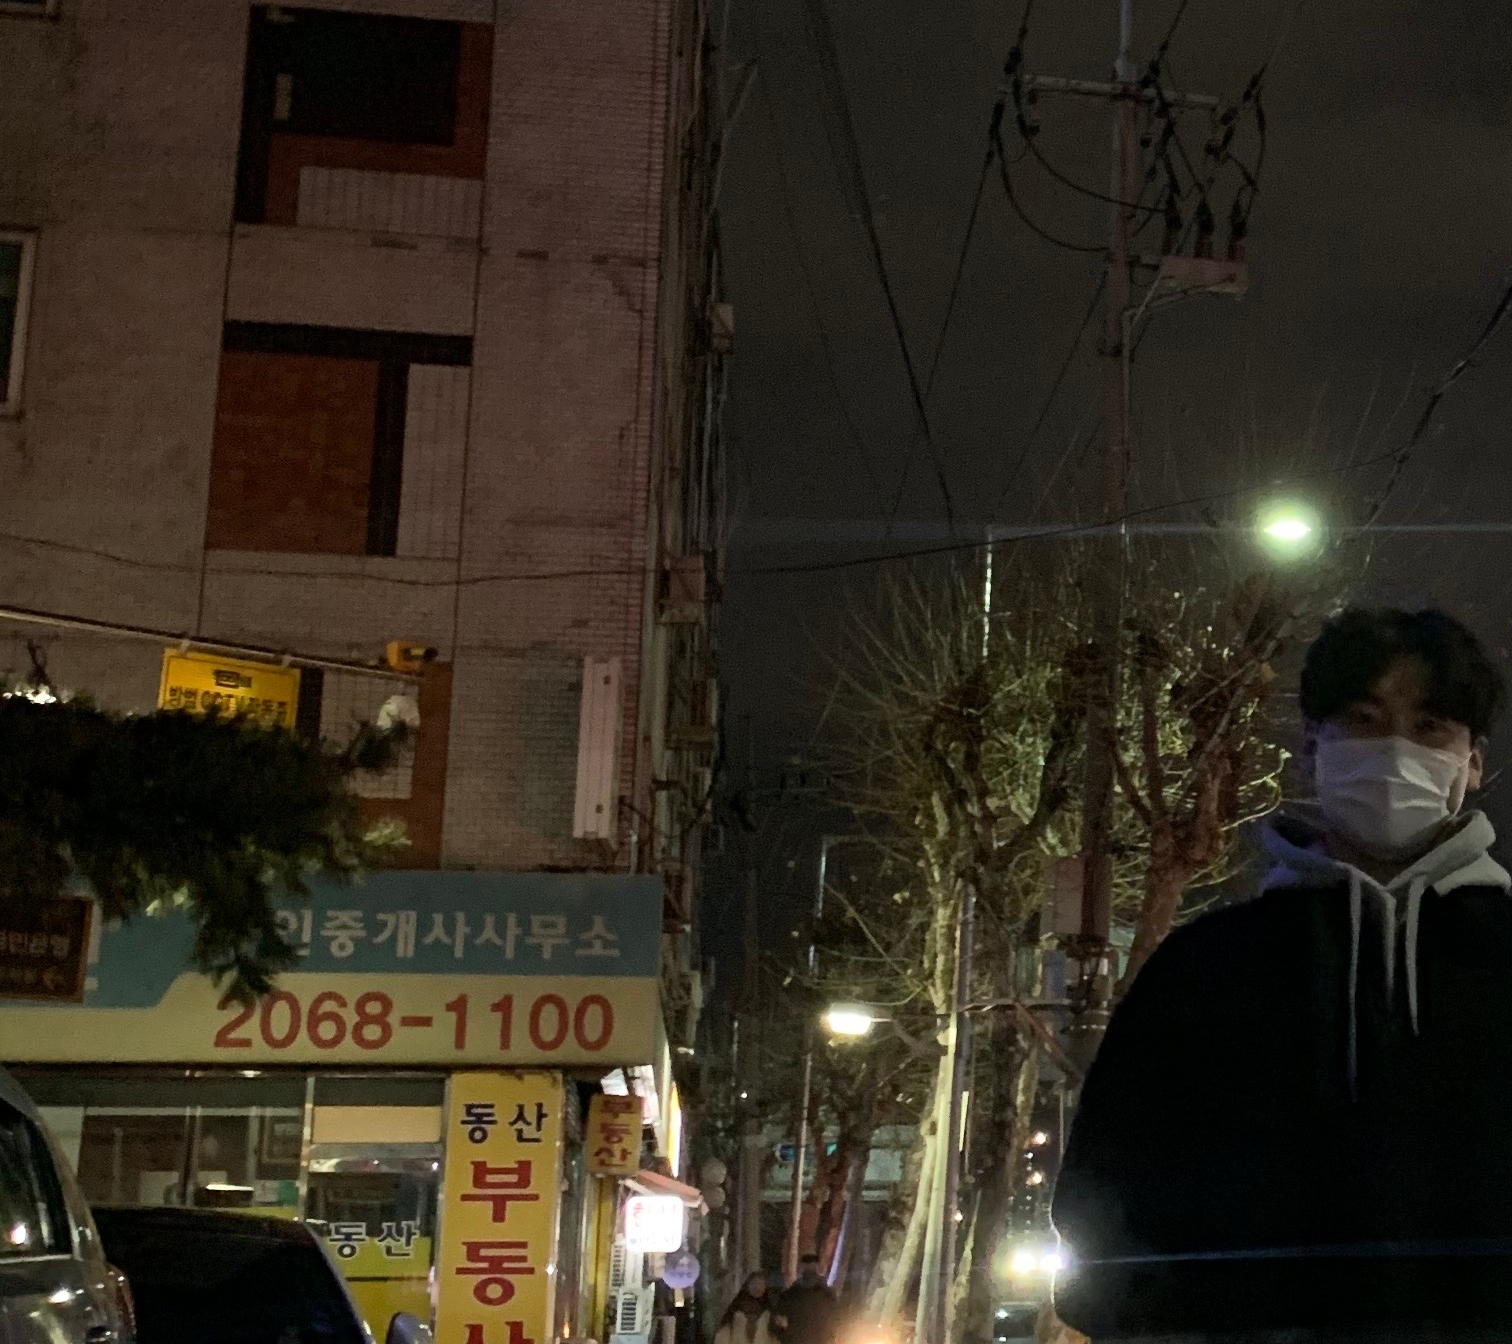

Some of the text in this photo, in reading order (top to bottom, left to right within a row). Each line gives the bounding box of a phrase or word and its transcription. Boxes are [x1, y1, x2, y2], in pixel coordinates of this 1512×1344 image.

[277, 909, 620, 960] 인중개사사무소
[214, 991, 615, 1052] 2068-1100
[594, 1099, 633, 1167] 부동산
